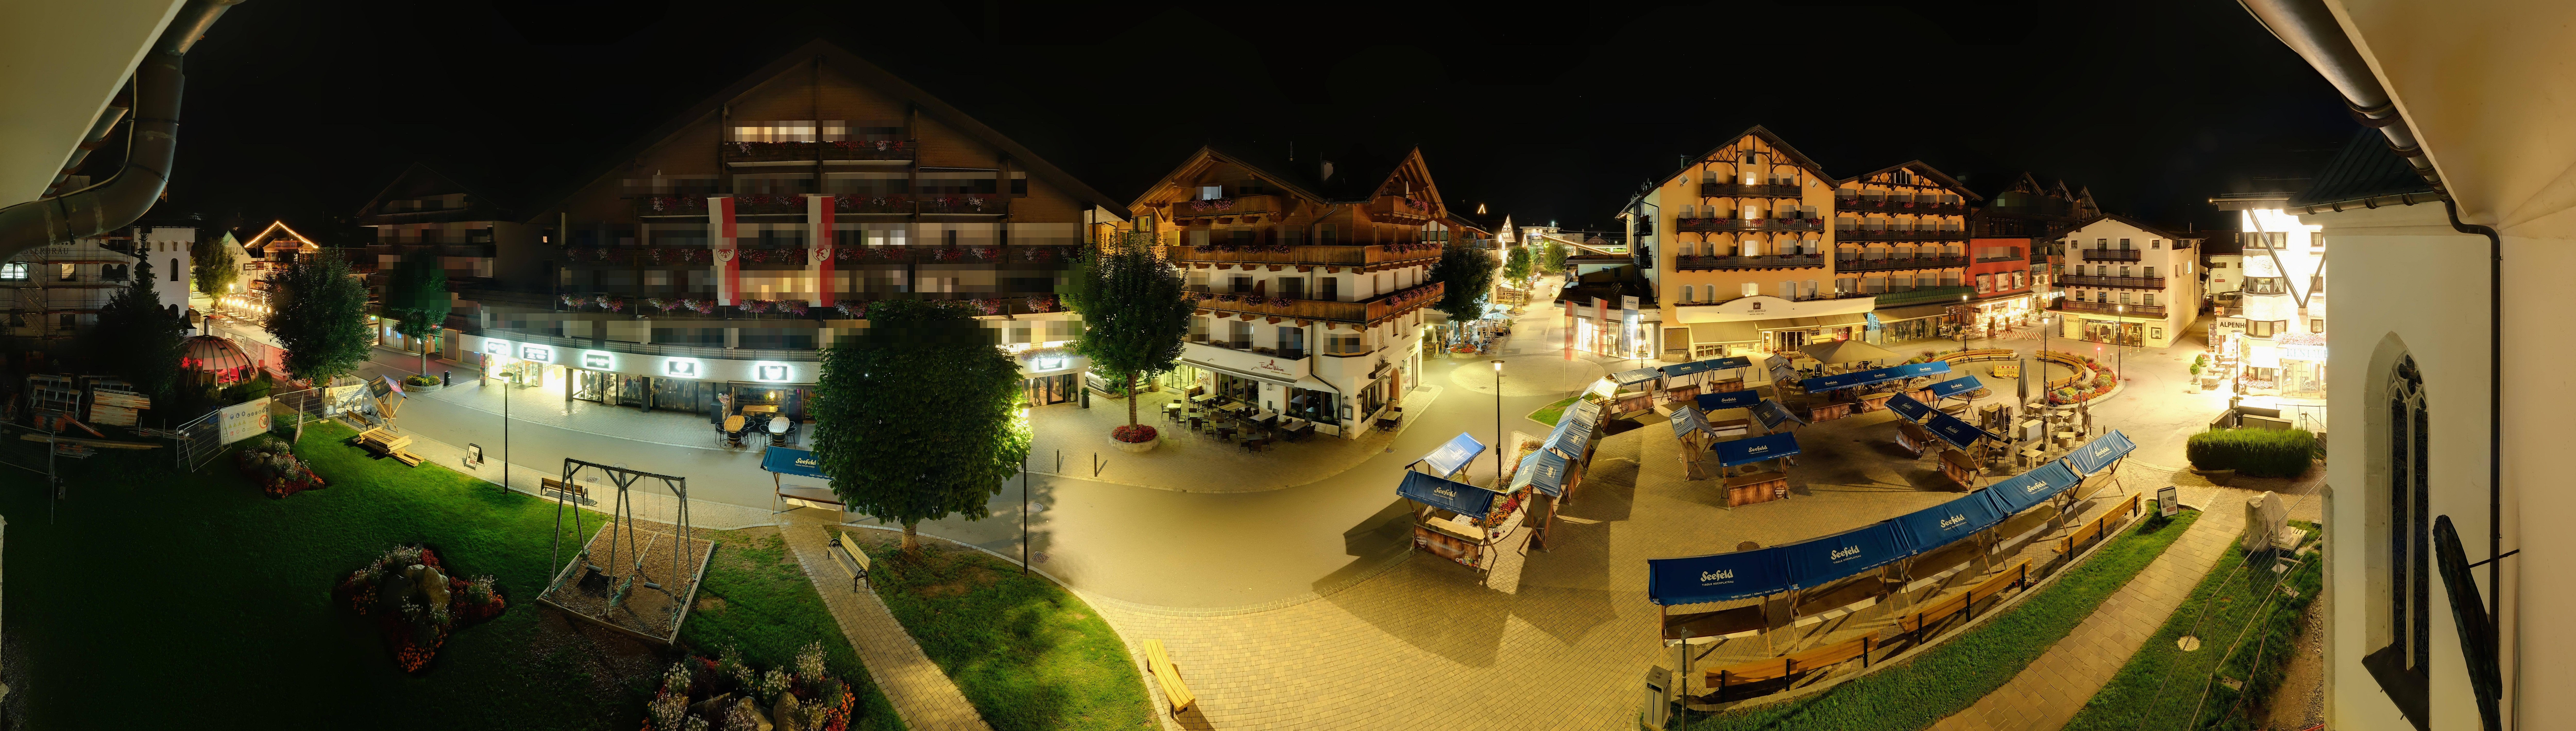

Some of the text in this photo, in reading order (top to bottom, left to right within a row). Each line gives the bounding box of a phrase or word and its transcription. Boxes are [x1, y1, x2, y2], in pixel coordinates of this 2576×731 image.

[1407, 343, 1415, 352] SAILER
[1376, 365, 1391, 377] RESTAURANT
[336, 389, 364, 402] Glanzbuam
[2095, 446, 2110, 456] Seefeld
[1434, 487, 1457, 497] Seefeld
[2027, 480, 2047, 492] Seefeld
[1941, 513, 1965, 528] Seefeld
[1831, 545, 1860, 560] Seefeld
[1700, 569, 1734, 582] Seefeld
